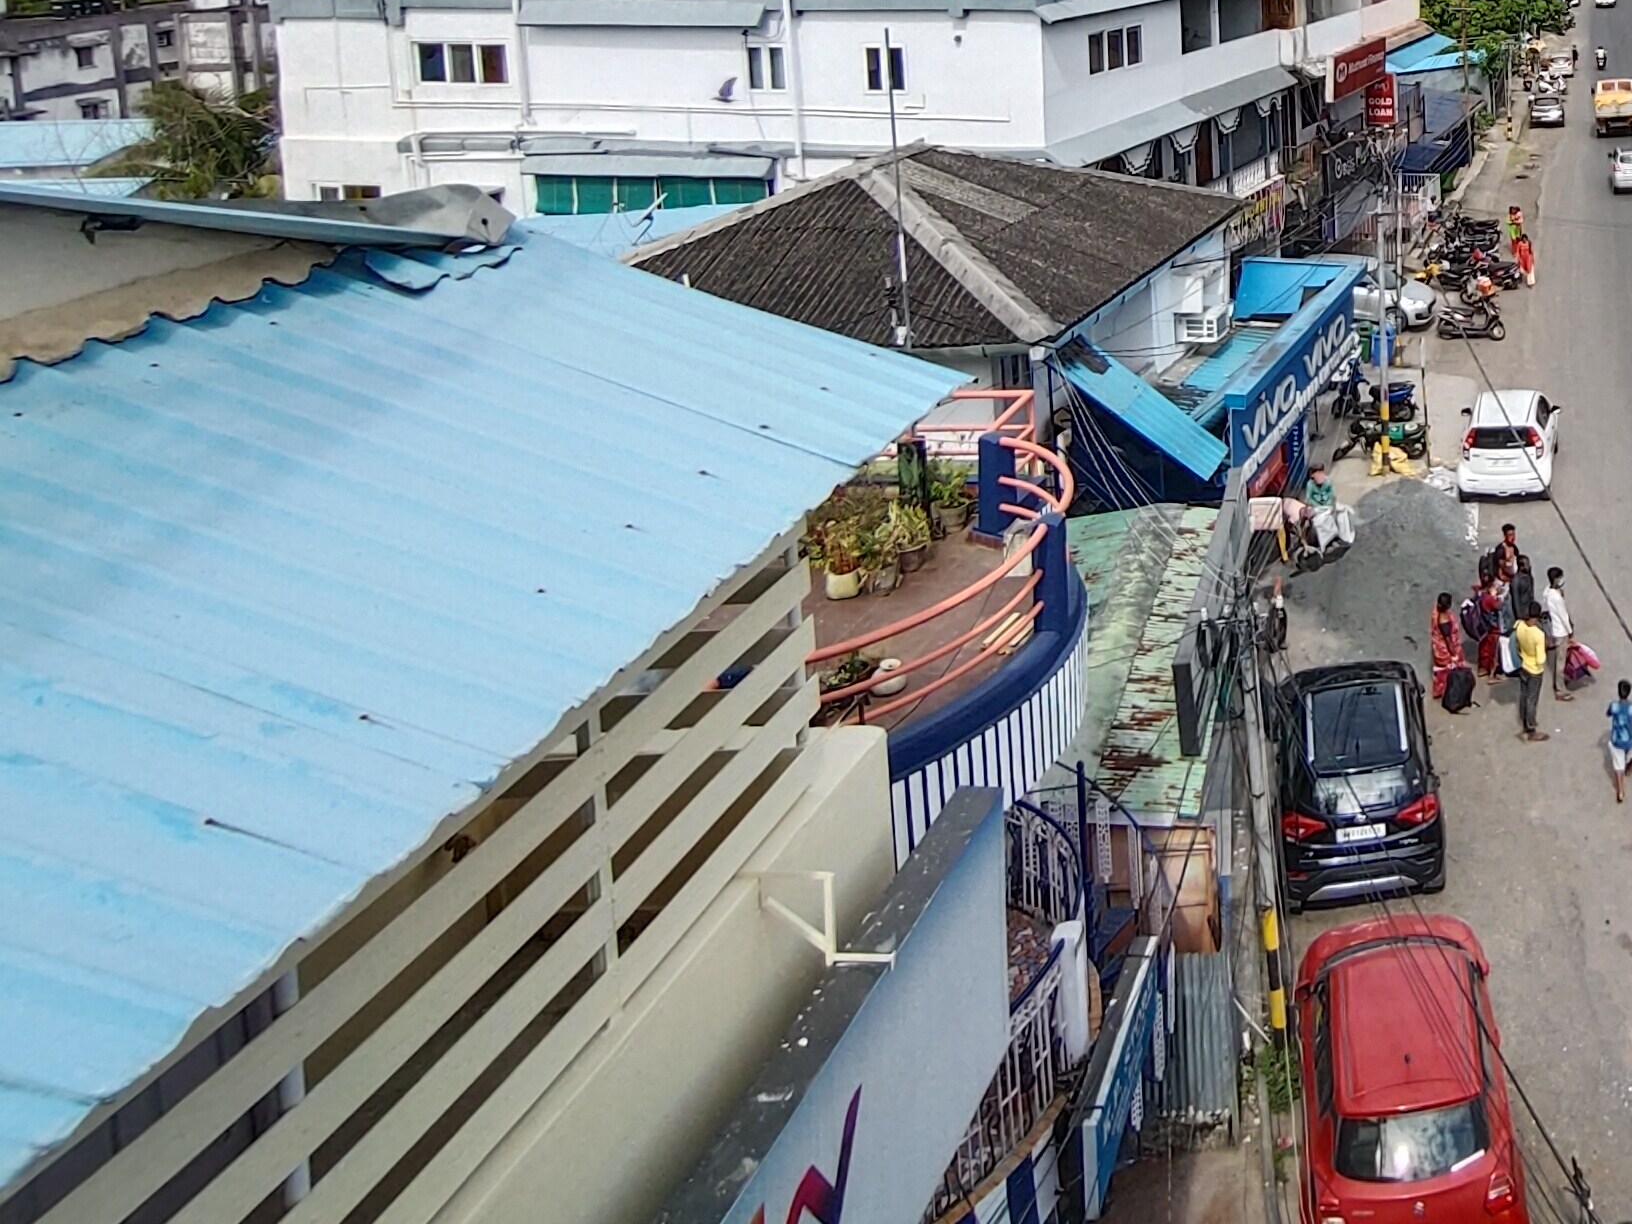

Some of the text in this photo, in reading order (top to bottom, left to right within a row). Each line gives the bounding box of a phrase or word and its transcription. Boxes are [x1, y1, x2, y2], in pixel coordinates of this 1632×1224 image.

[1368, 97, 1393, 105] GOLD
[1368, 108, 1393, 116] LOAN
[1242, 373, 1297, 450] vivo
[1303, 313, 1346, 378] vivo
